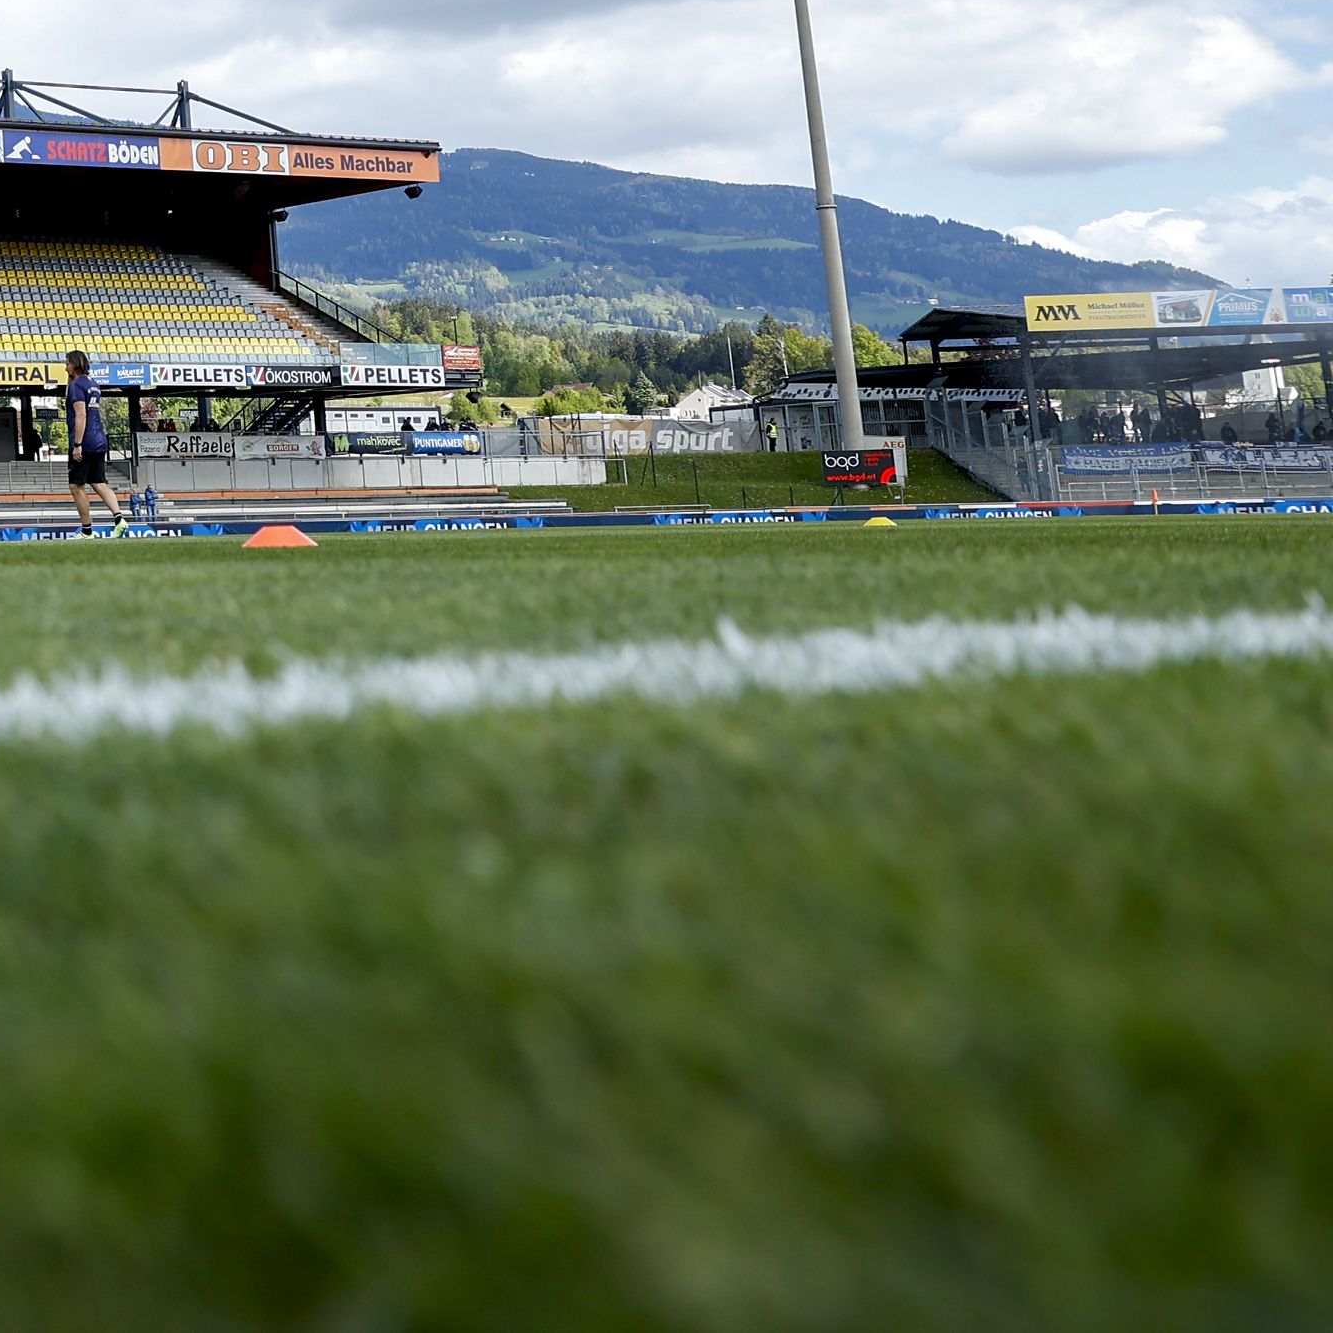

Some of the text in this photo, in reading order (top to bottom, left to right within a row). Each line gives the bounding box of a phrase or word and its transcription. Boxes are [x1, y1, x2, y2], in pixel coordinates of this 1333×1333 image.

[196, 142, 285, 172] OBI
[293, 153, 413, 174] Alles Machbar
[1218, 302, 1258, 312] PRIMUS
[173, 368, 245, 383] PELLETS
[266, 368, 331, 384] ÖKOSTROM
[365, 367, 441, 384] PELLETS
[140, 436, 167, 444] Restaurant
[167, 435, 231, 453] Raffaele
[357, 436, 401, 446] mahkovec
[414, 438, 463, 448] PUNTIGAMER
[656, 427, 733, 455] sport
[883, 441, 905, 449] AEG
[140, 444, 161, 453] Pizzeria
